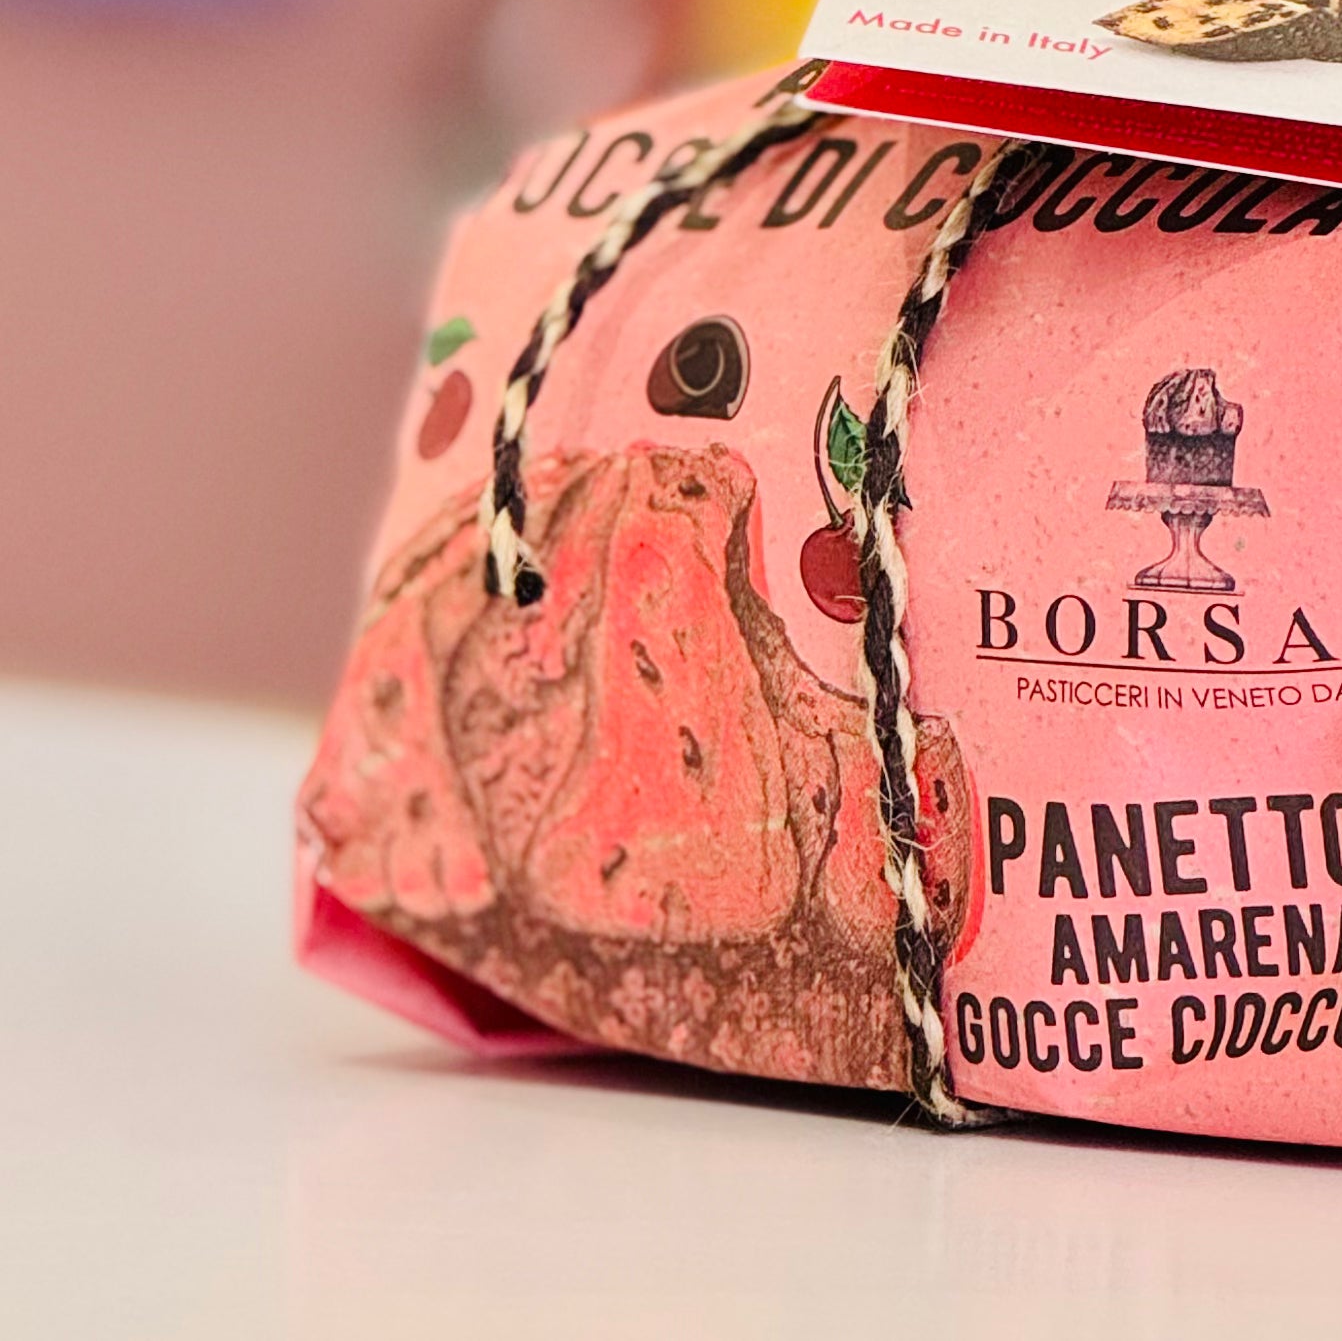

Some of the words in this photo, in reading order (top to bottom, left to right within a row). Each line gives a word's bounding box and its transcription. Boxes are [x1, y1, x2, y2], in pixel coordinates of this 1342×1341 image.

[847, 9, 963, 38] Made
[979, 26, 1011, 45] in
[1028, 32, 1114, 60] Italy
[760, 137, 897, 229] DI
[1017, 676, 1149, 709] PASTICCERI
[1157, 685, 1183, 708] IN
[1195, 684, 1302, 710] VENETO
[956, 991, 1144, 1073] GOCCE
